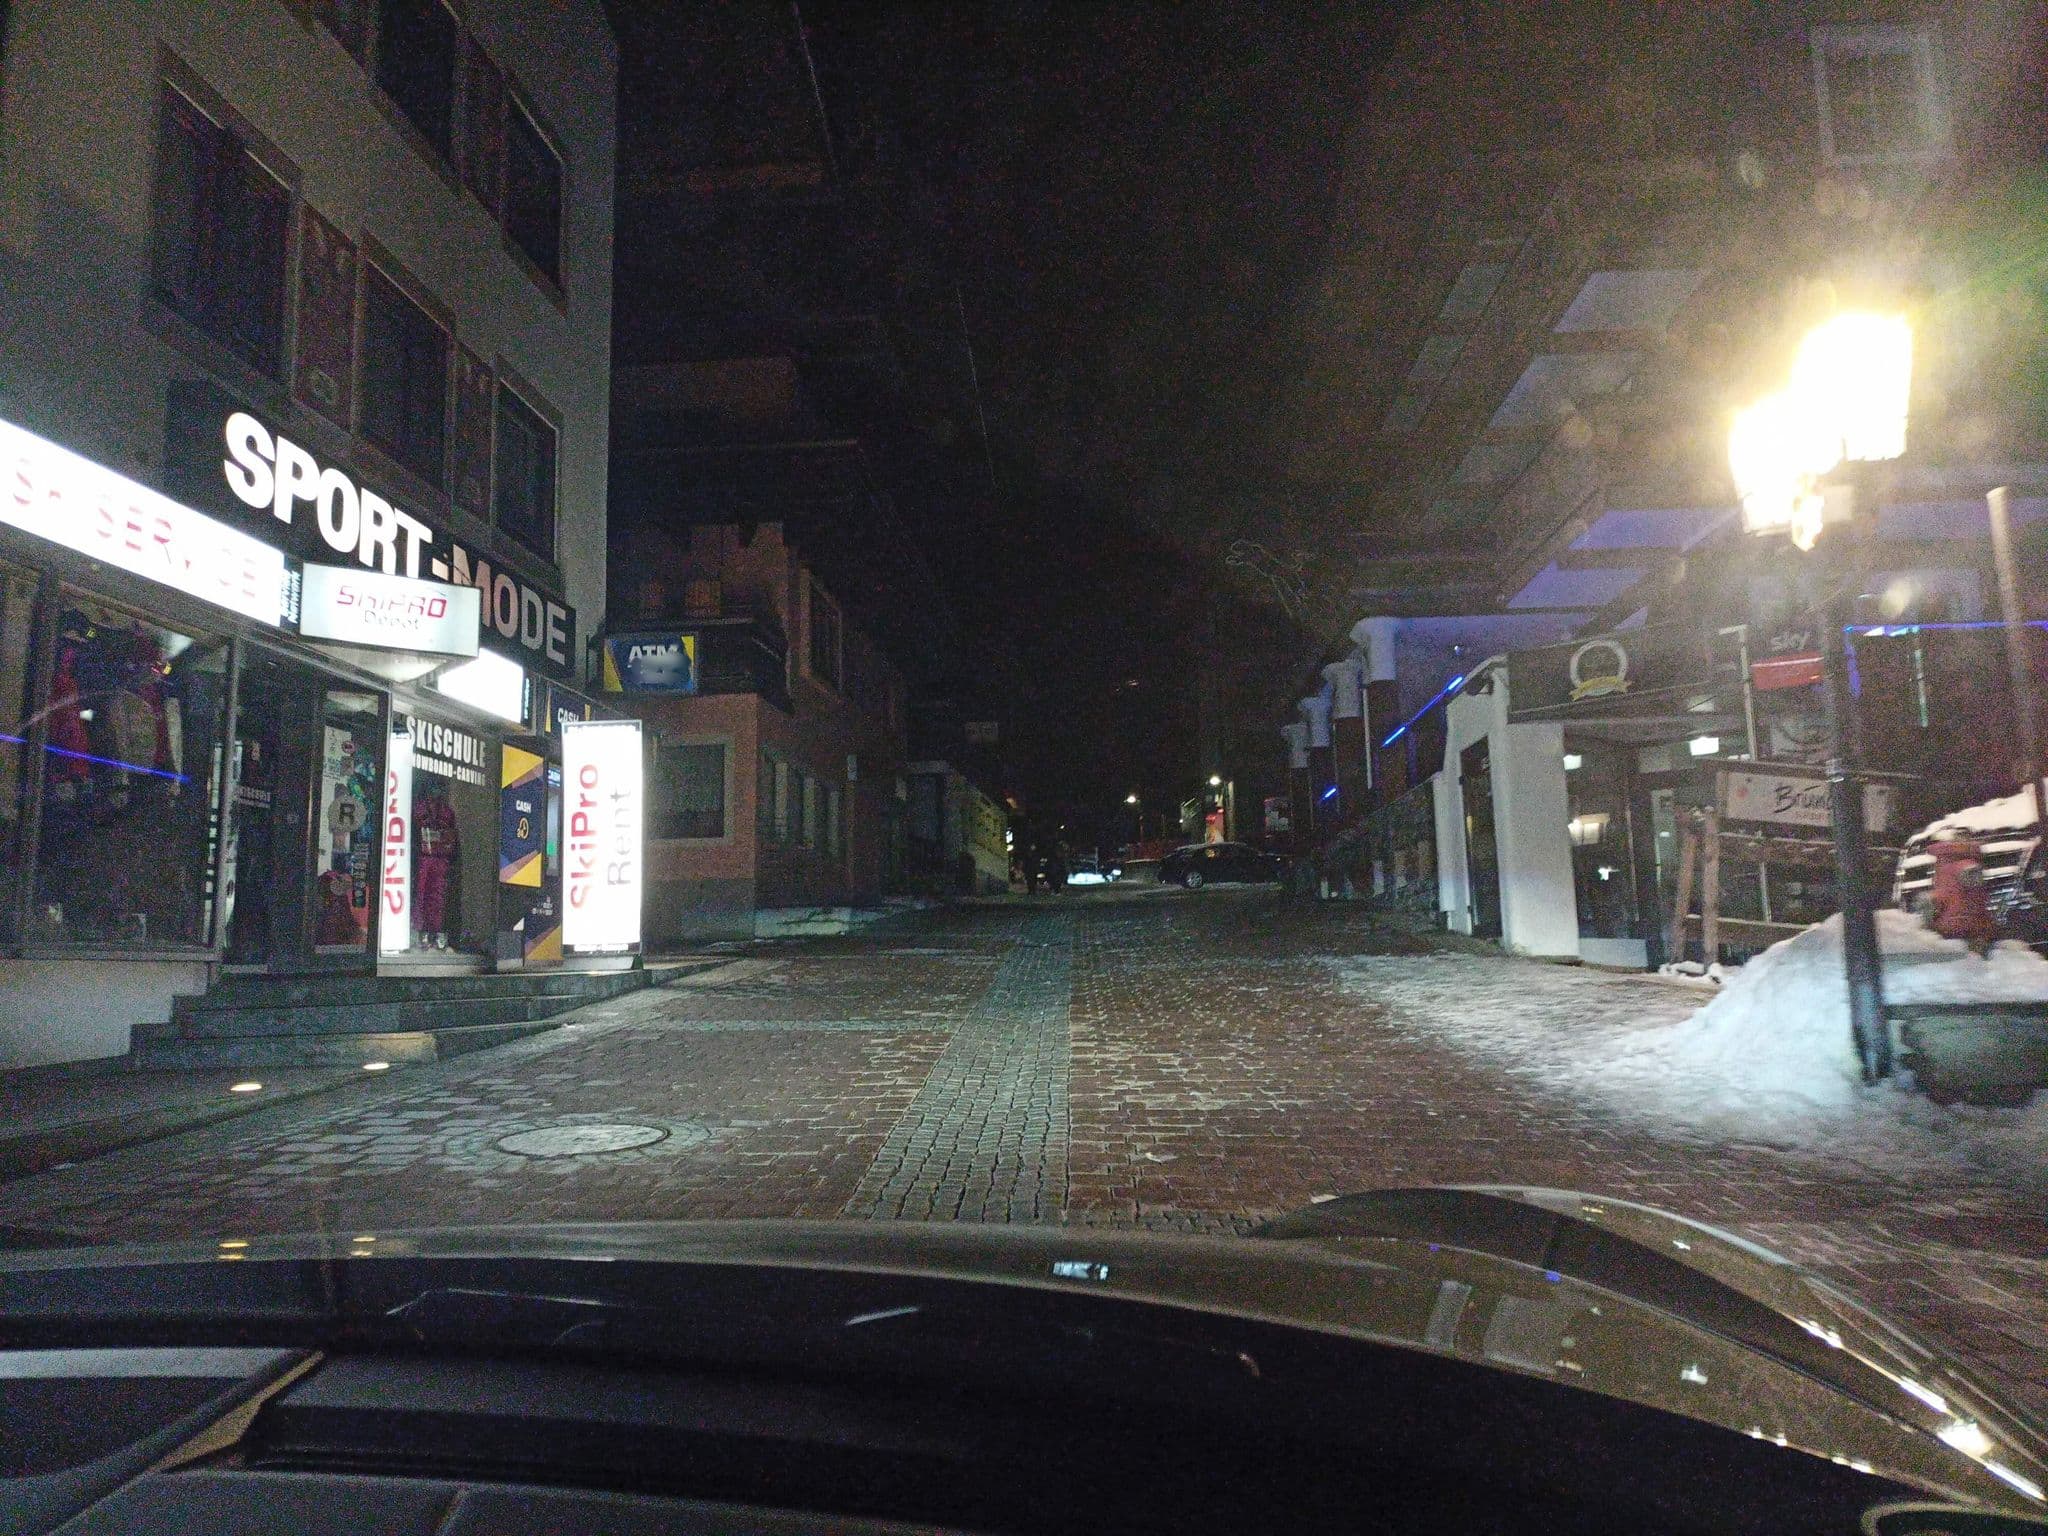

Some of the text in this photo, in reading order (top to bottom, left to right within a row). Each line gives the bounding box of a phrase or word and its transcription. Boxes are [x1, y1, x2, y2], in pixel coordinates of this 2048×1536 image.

[406, 715, 486, 768] SKISCHULE
[515, 799, 532, 814] CASH
[570, 764, 598, 908] SkiPro
